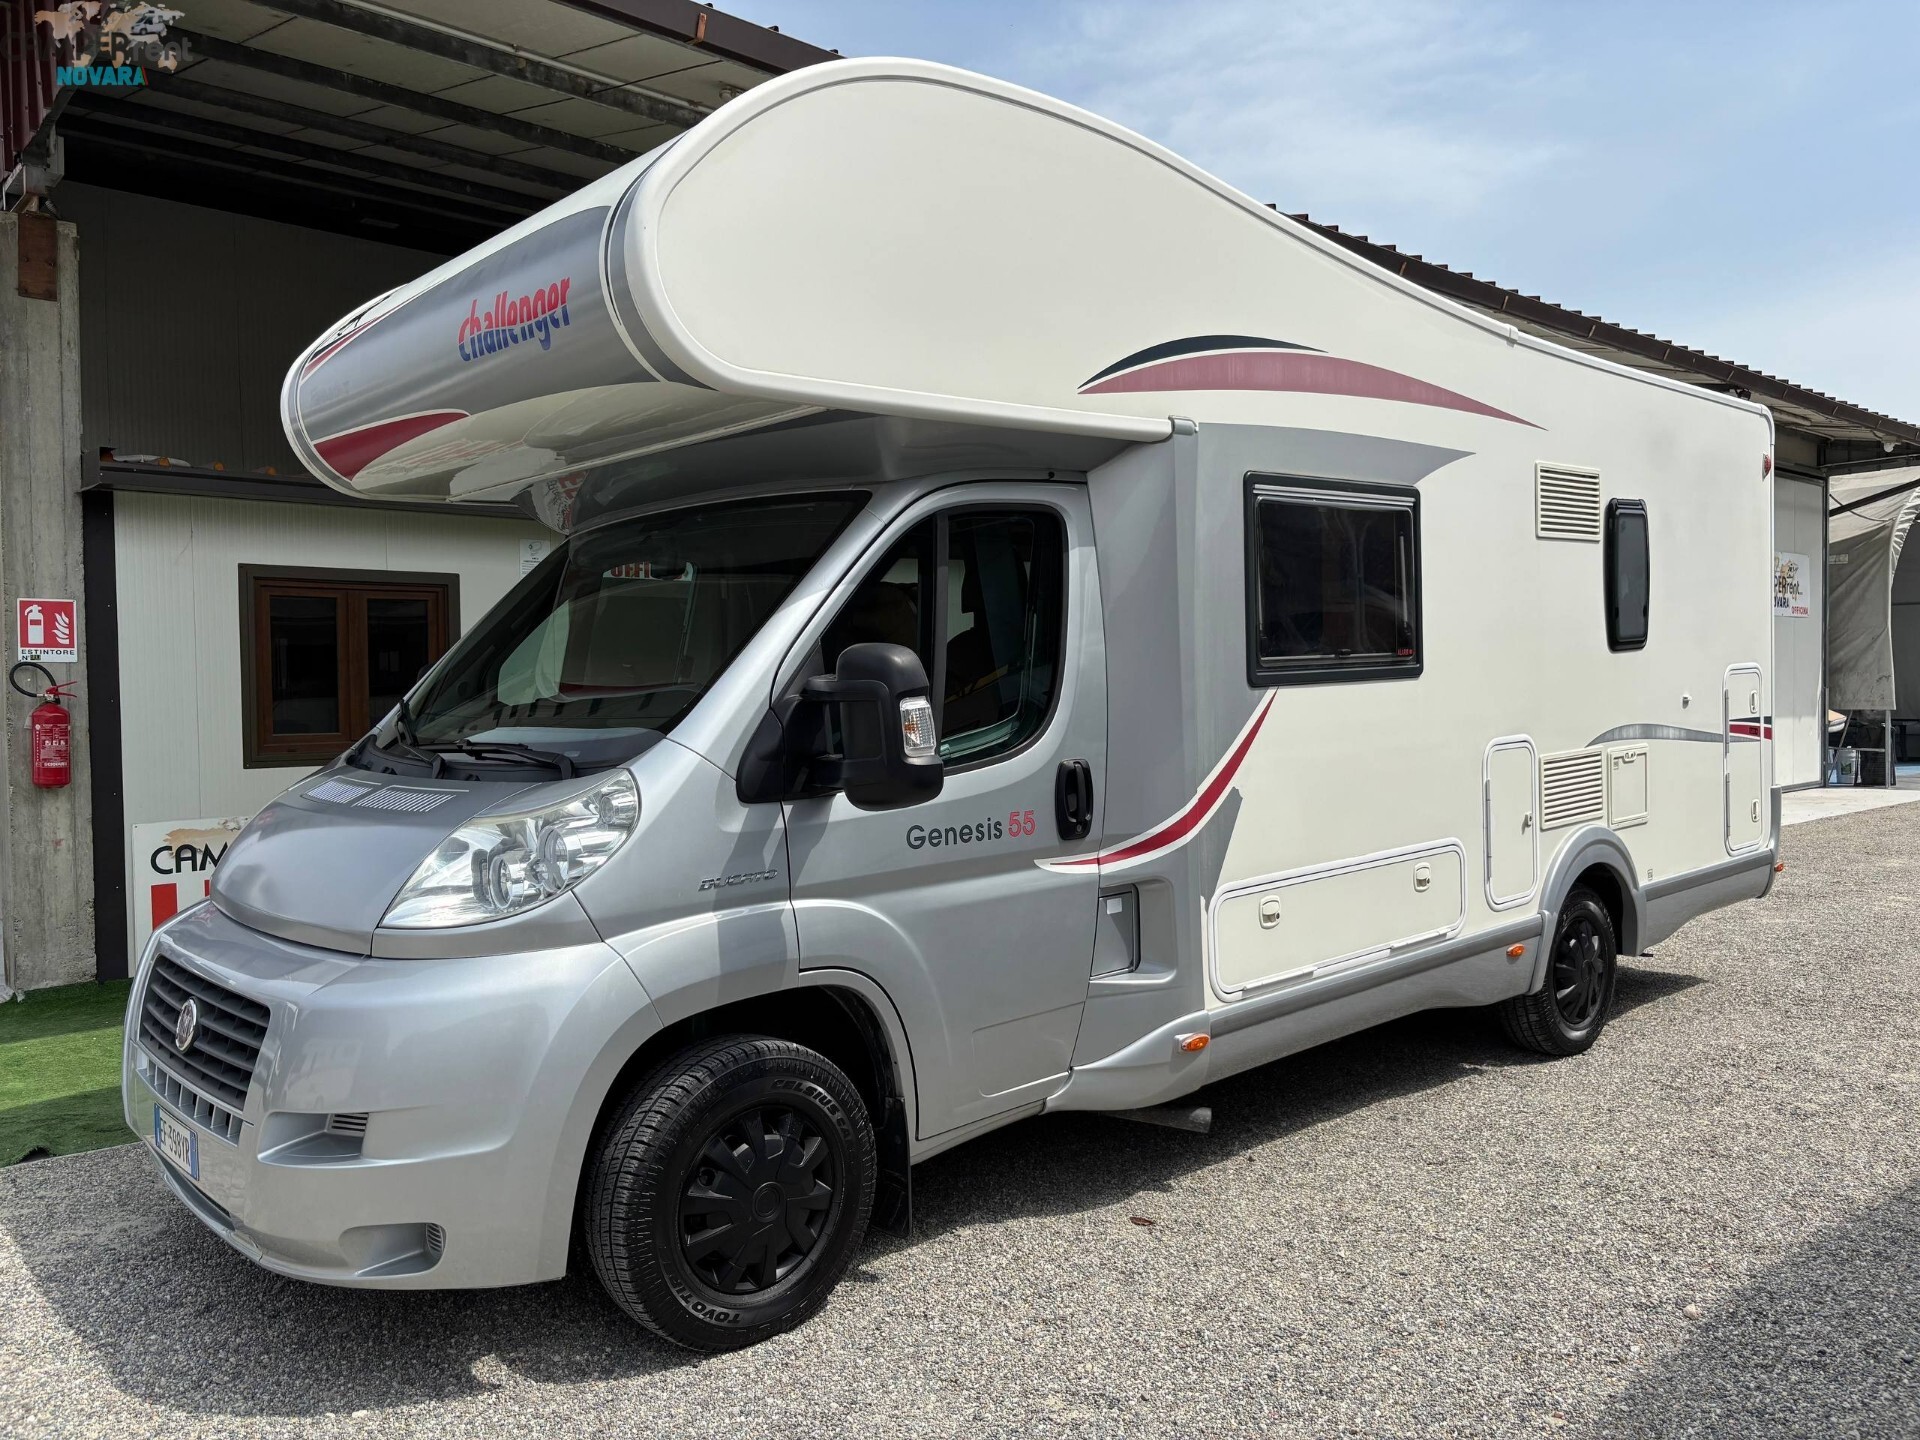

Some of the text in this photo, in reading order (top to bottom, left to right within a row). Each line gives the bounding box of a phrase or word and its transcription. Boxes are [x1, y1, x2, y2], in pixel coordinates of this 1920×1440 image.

[906, 809, 1036, 850] Genesis 55
[698, 868, 778, 891] DUCATO
[770, 1079, 841, 1116] CELSIUS
[691, 1301, 742, 1324] TOYO
